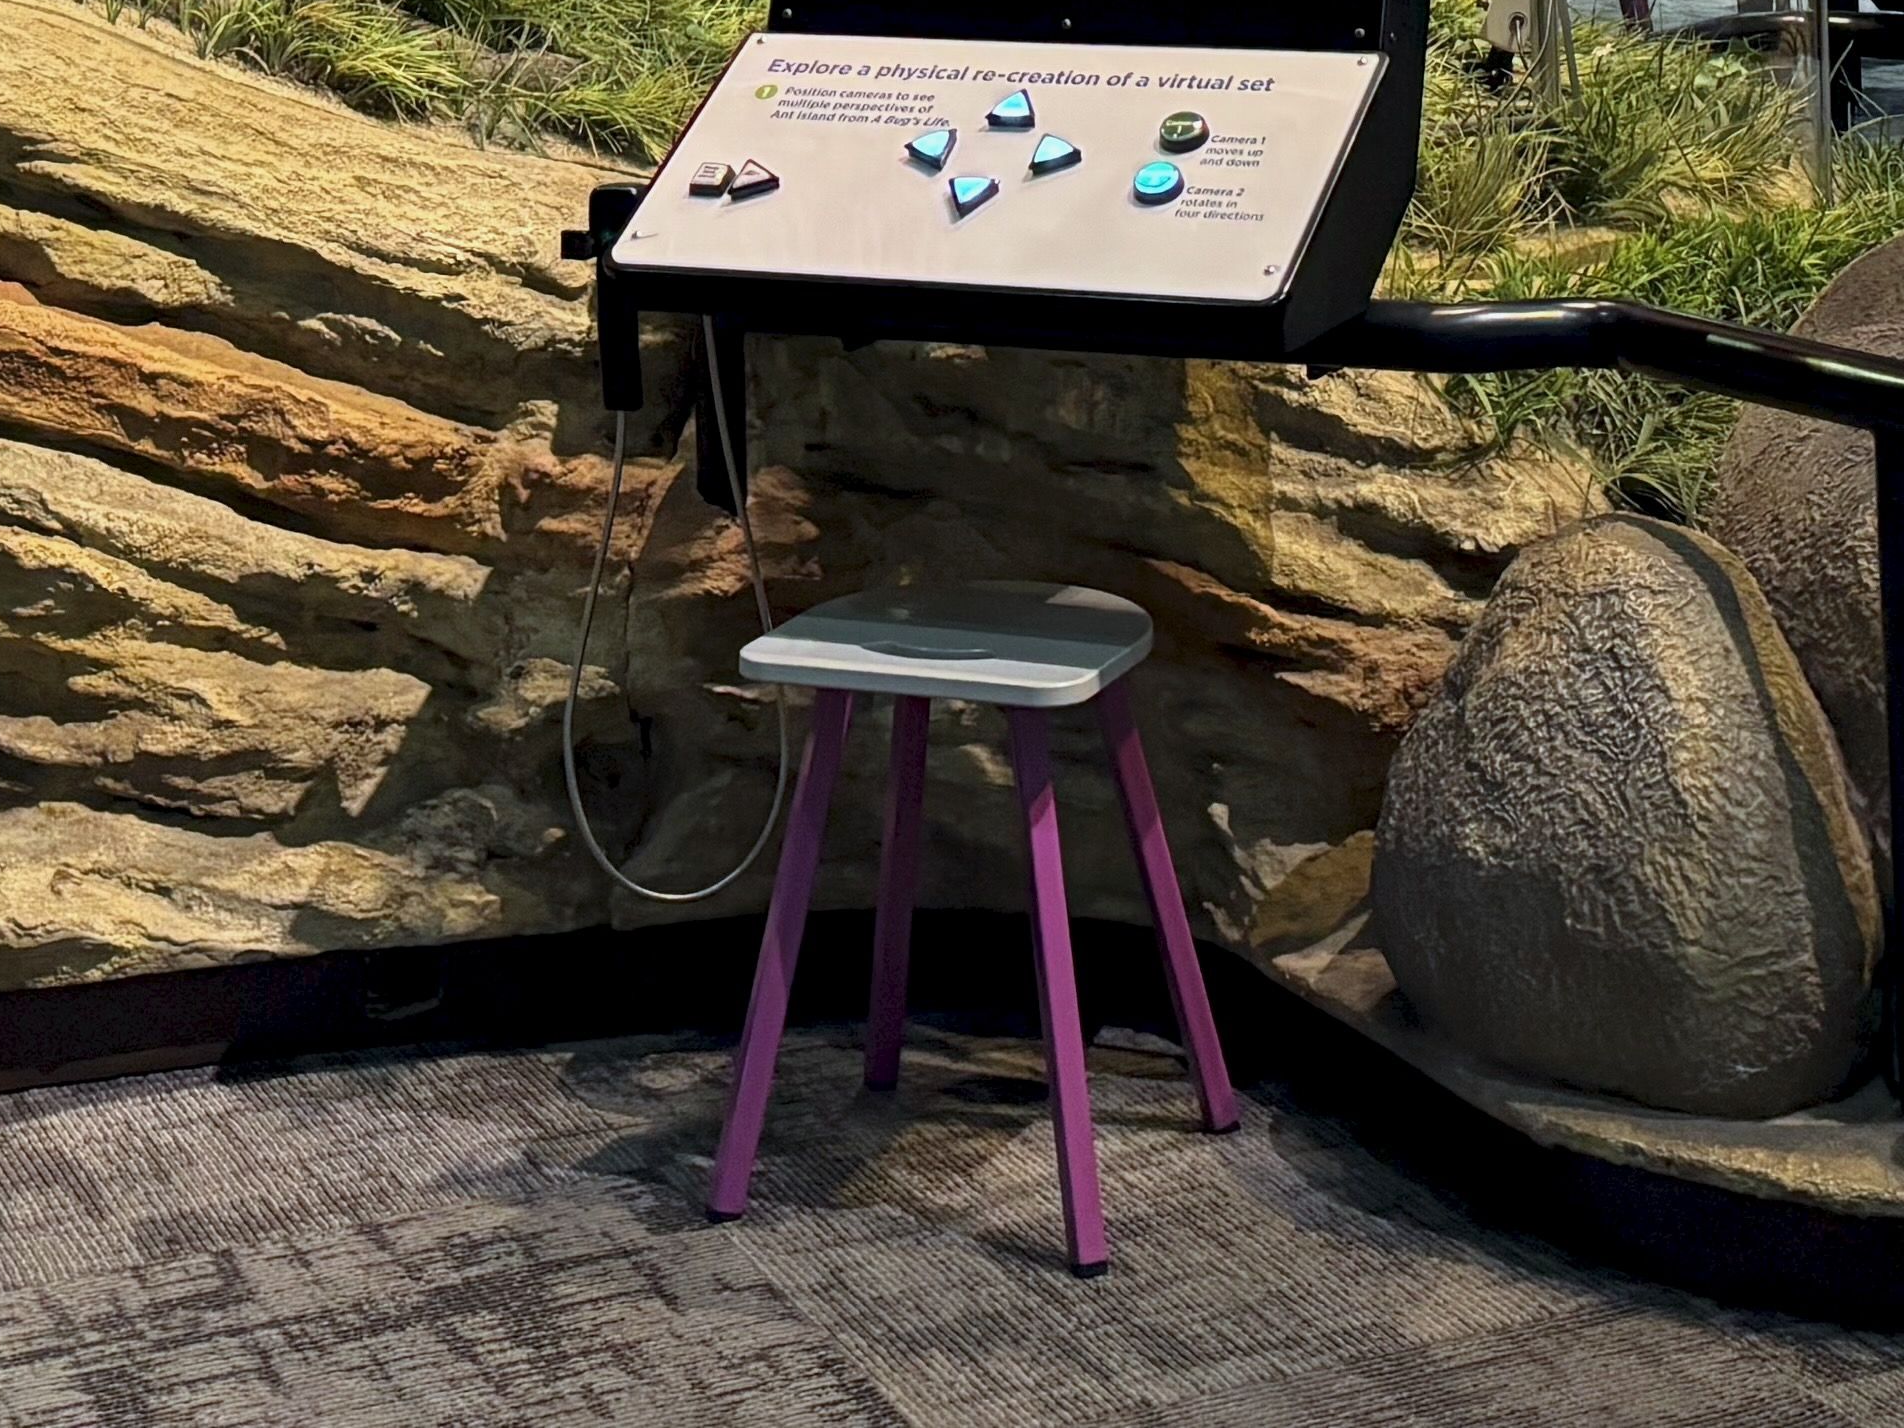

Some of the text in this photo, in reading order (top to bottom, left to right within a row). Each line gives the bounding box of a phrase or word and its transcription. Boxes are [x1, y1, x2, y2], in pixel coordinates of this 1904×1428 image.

[767, 58, 1276, 92] Explore a physical re-creation of a virtual set
[785, 86, 935, 102] Position cameras to see
[777, 98, 935, 114] multiple perspectives of
[770, 110, 794, 120] Ant
[796, 110, 835, 122] Island
[838, 112, 869, 123] from
[870, 115, 881, 123] A
[1211, 134, 1267, 145] Camera 1
[1205, 147, 1264, 157] moves up
[1199, 158, 1260, 167] and down
[1186, 186, 1245, 197] Camera 2
[1180, 198, 1238, 208] rotates in
[1174, 208, 1265, 221] four directions
